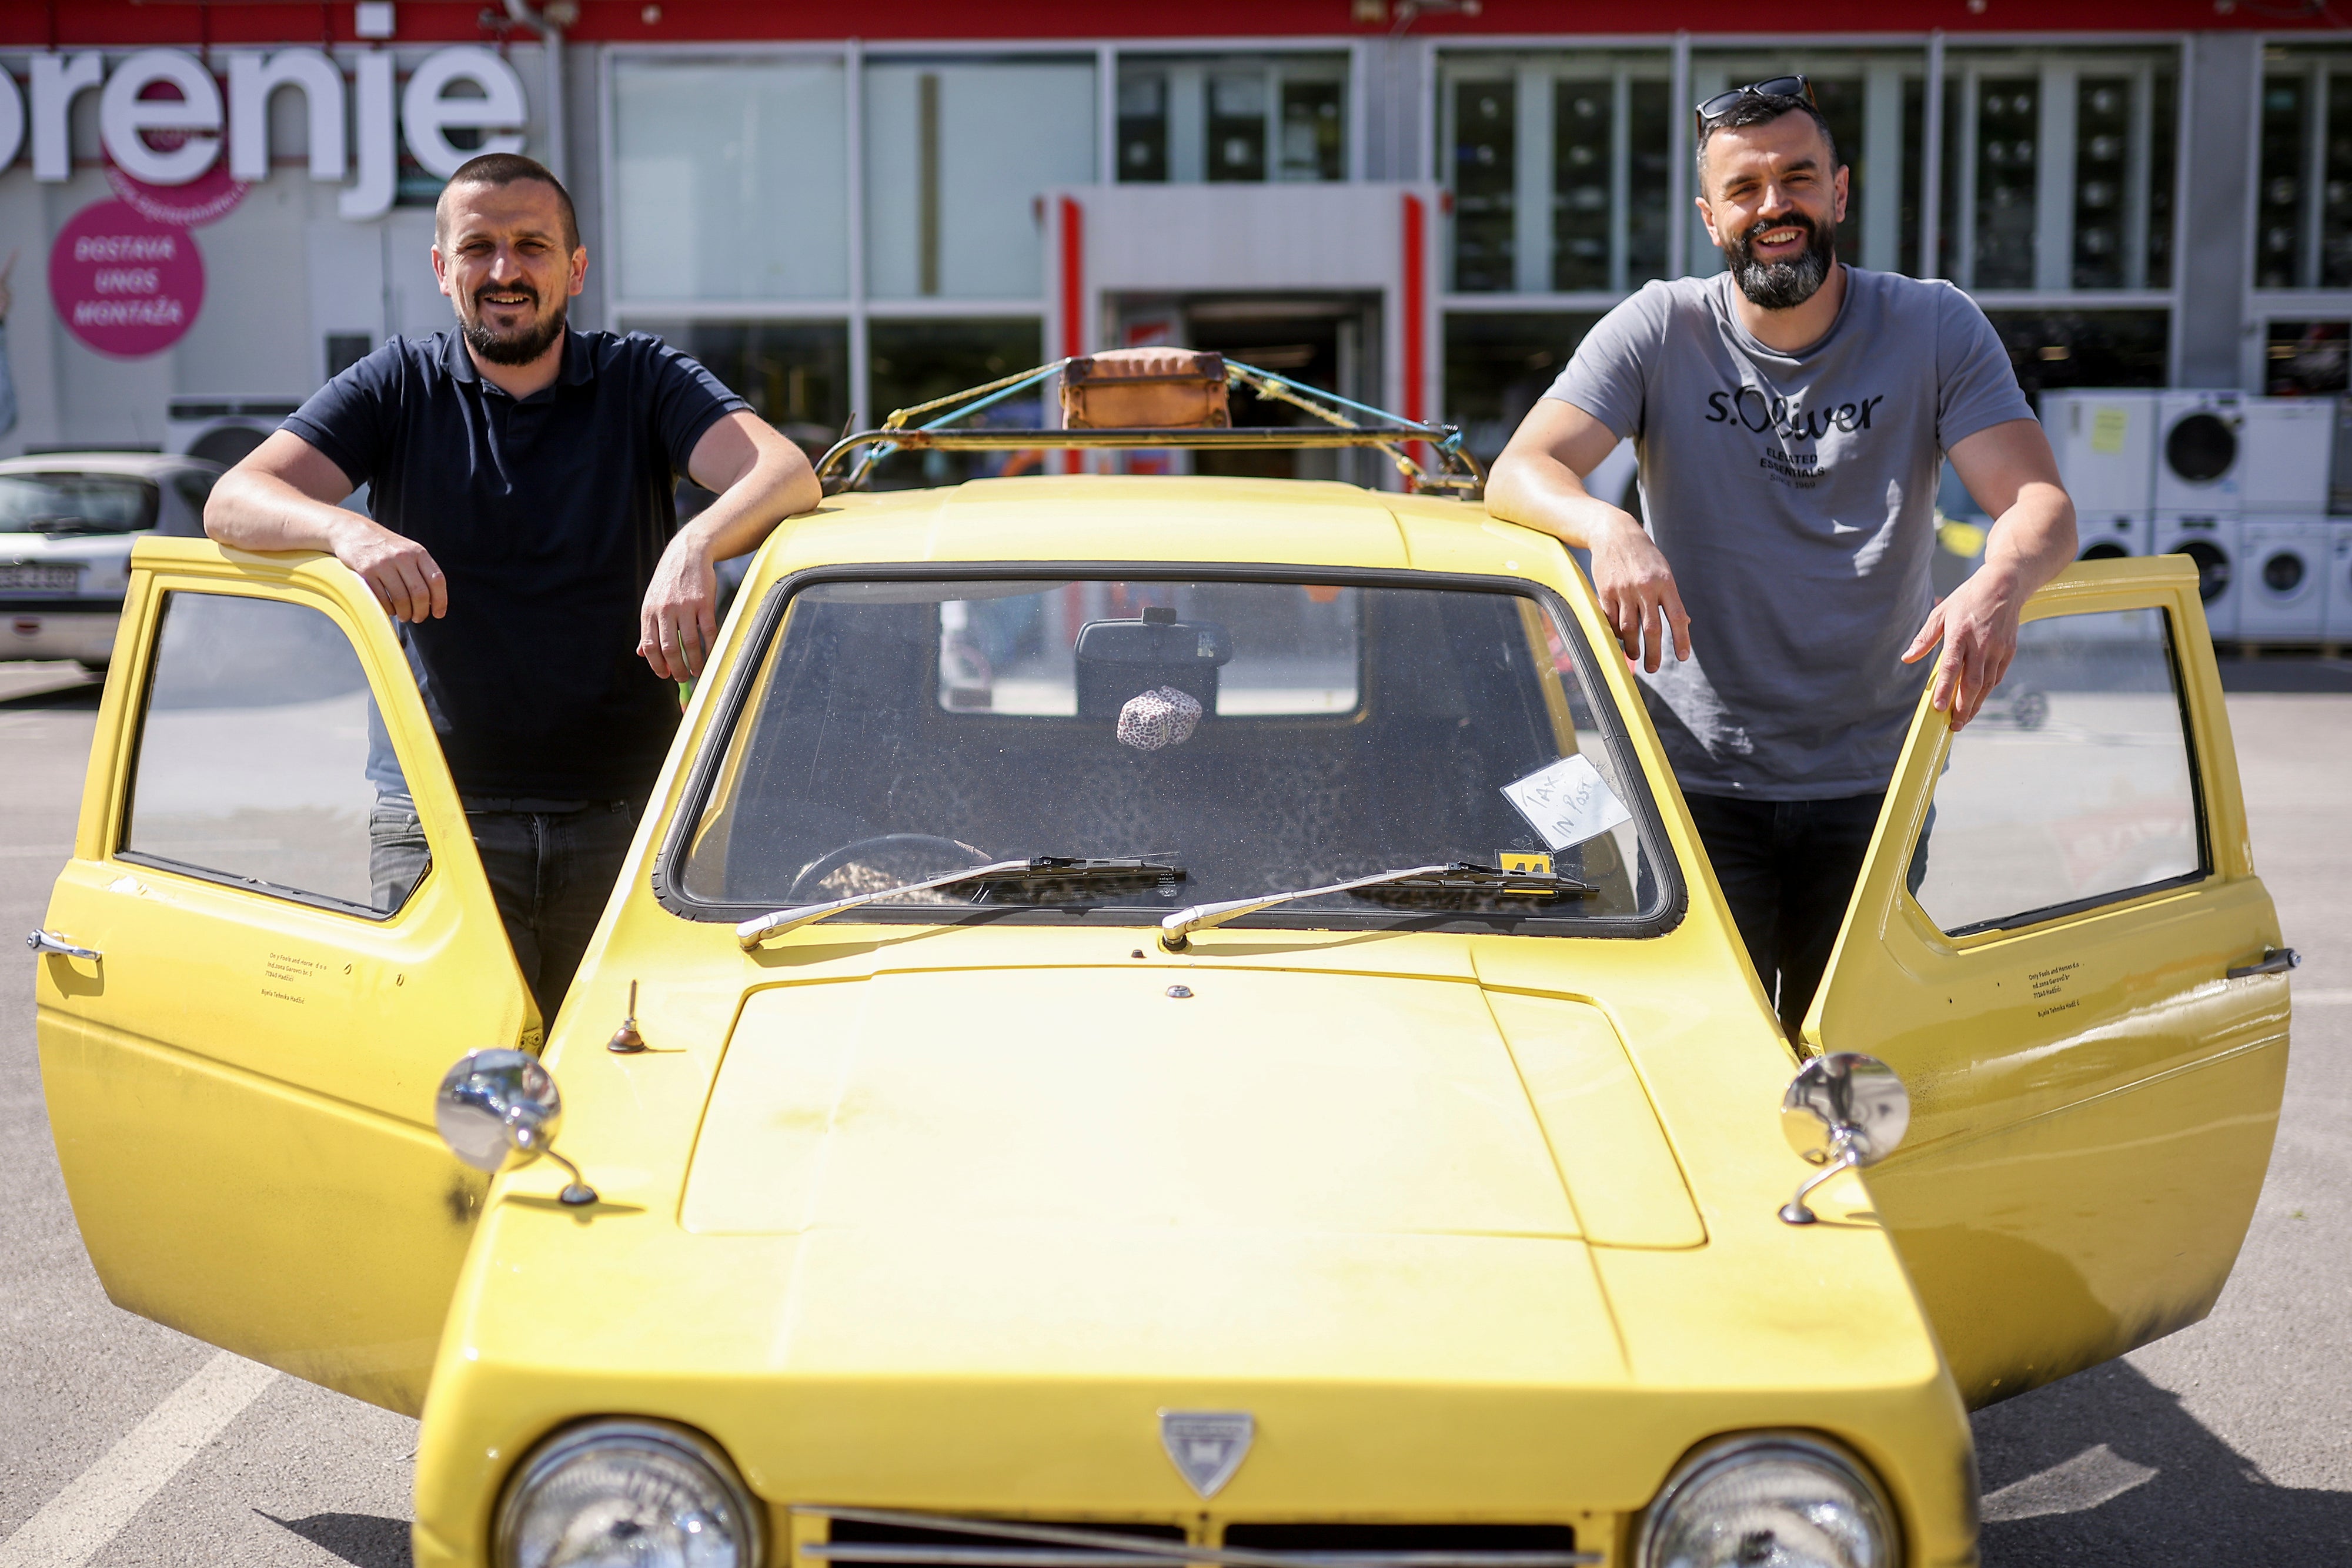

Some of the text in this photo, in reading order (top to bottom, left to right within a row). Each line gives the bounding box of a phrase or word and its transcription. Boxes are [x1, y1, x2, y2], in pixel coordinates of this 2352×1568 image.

[0, 1, 528, 221] renje
[74, 236, 175, 262] DOSTAVA
[94, 268, 159, 294] UNOS
[74, 295, 184, 326] MONTAŽA
[1705, 384, 1883, 441] s.Oliver
[1760, 457, 1825, 478] ESSENTIALS
[1766, 447, 1818, 464] ELEVATED
[1770, 473, 1816, 490] SINCE 1969
[1521, 775, 1559, 808] TAX
[1552, 774, 1592, 839] IN POST
[2049, 974, 2065, 984] Garovci
[261, 988, 273, 997] Bijela
[273, 991, 289, 1000] Tehnika
[2038, 1009, 2049, 1017] Bijela
[2049, 1004, 2065, 1013] Tehnika
